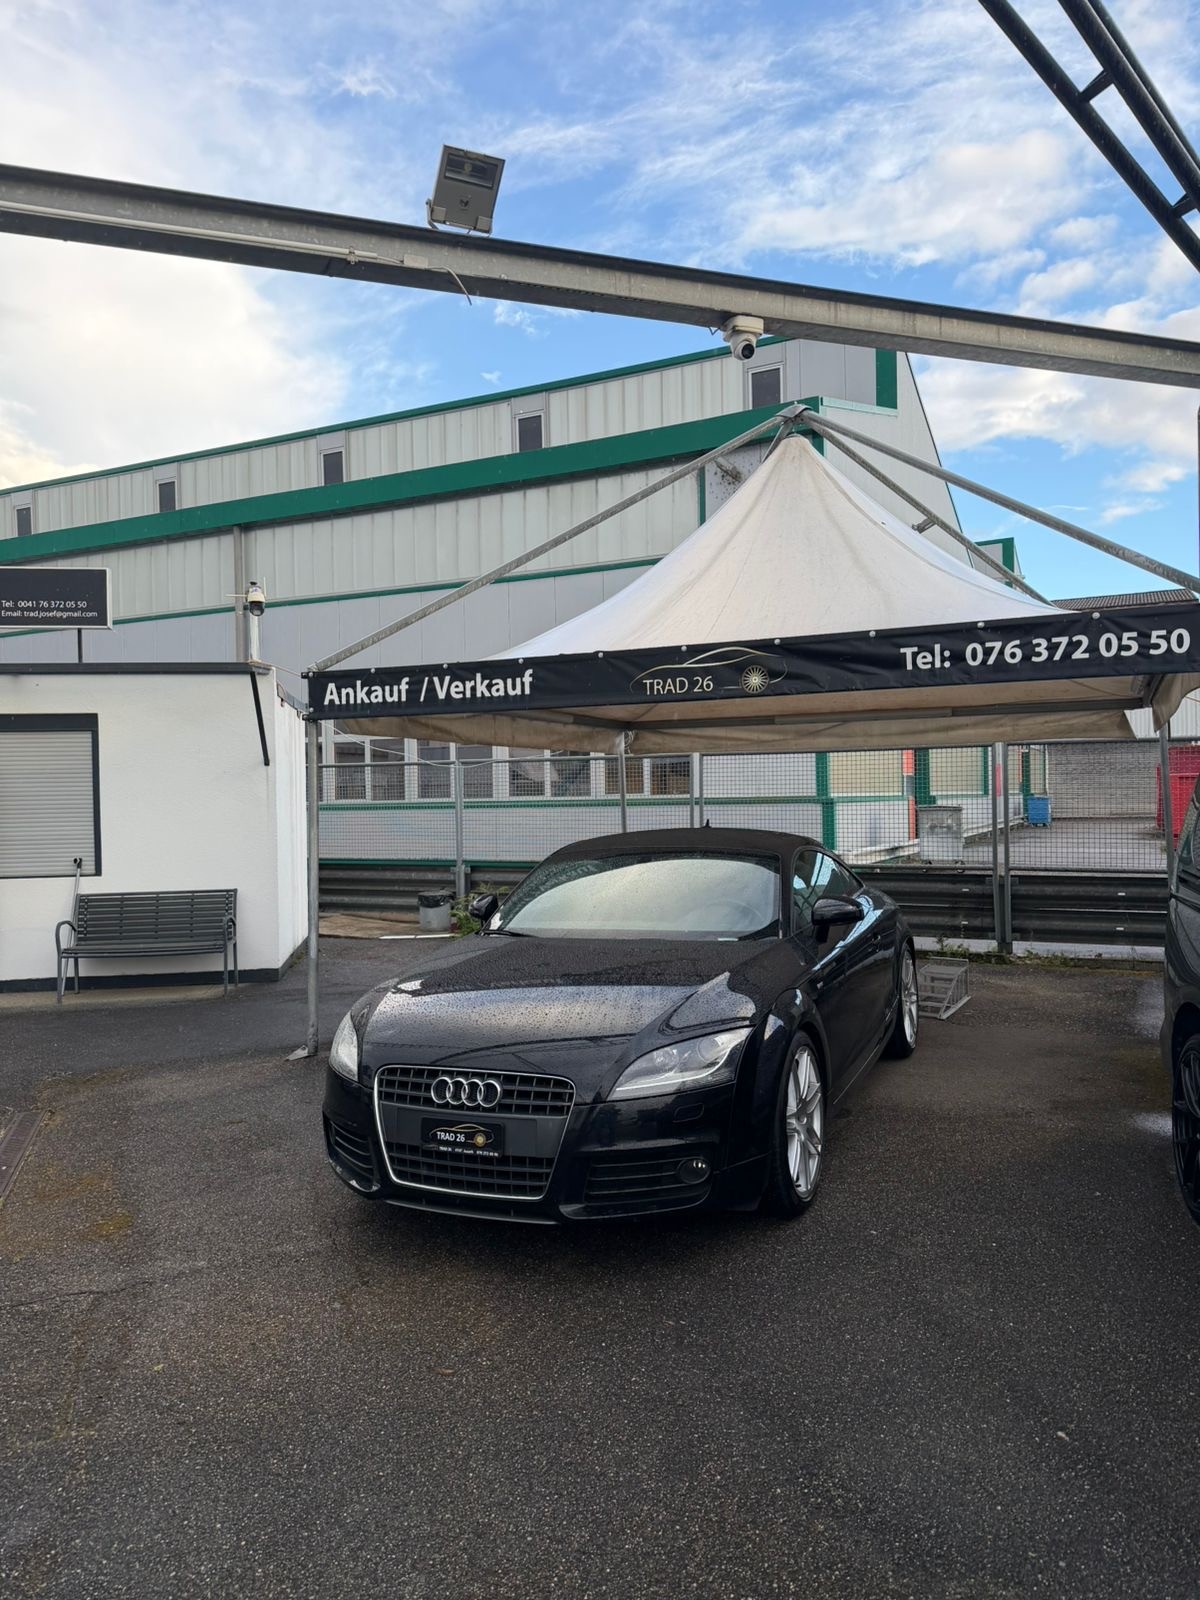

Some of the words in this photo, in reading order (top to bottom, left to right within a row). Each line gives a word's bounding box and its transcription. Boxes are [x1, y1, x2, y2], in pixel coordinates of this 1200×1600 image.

[1, 600, 15, 608] Tel:
[17, 600, 36, 608] 0041
[39, 600, 48, 608] 76
[50, 600, 64, 608] 372
[66, 600, 76, 608] 05
[78, 600, 87, 608] 50
[900, 644, 950, 671] Tel:
[965, 640, 1022, 666] 076
[1031, 635, 1090, 662] 372
[1099, 632, 1139, 658] 05
[1149, 628, 1191, 655] 50
[323, 677, 409, 706] Ankauf
[643, 677, 689, 695] TRAD
[693, 676, 714, 692] 26
[436, 1132, 455, 1140] TRAD
[456, 1134, 466, 1142] 26
